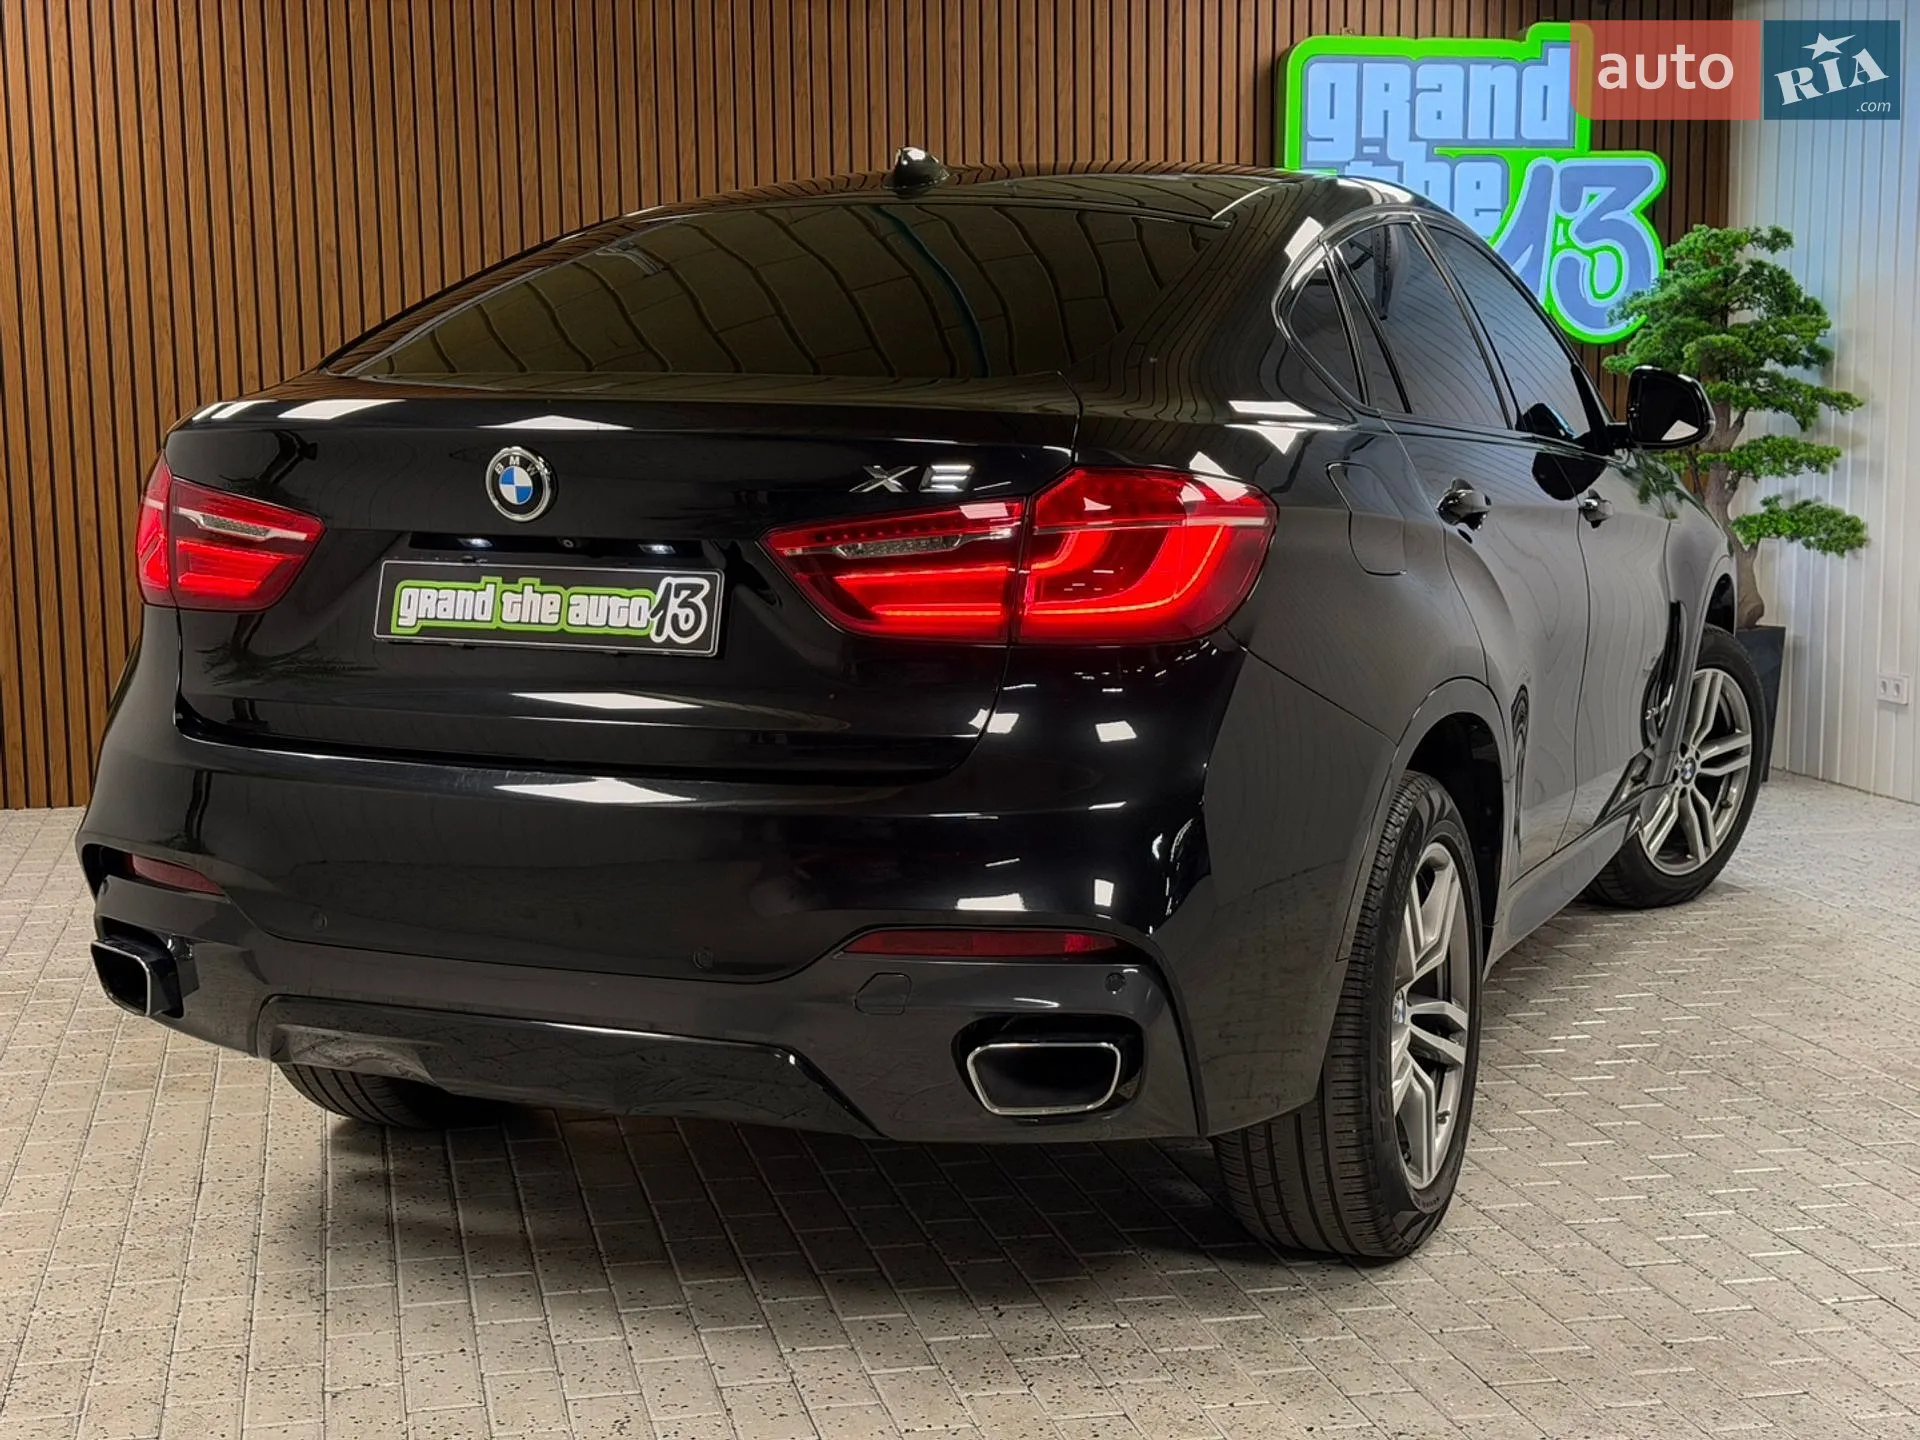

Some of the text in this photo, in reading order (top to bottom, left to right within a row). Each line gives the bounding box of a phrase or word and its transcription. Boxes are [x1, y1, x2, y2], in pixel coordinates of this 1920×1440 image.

[494, 455, 538, 477] BMW
[502, 585, 561, 625] the
[568, 594, 651, 629] auto
